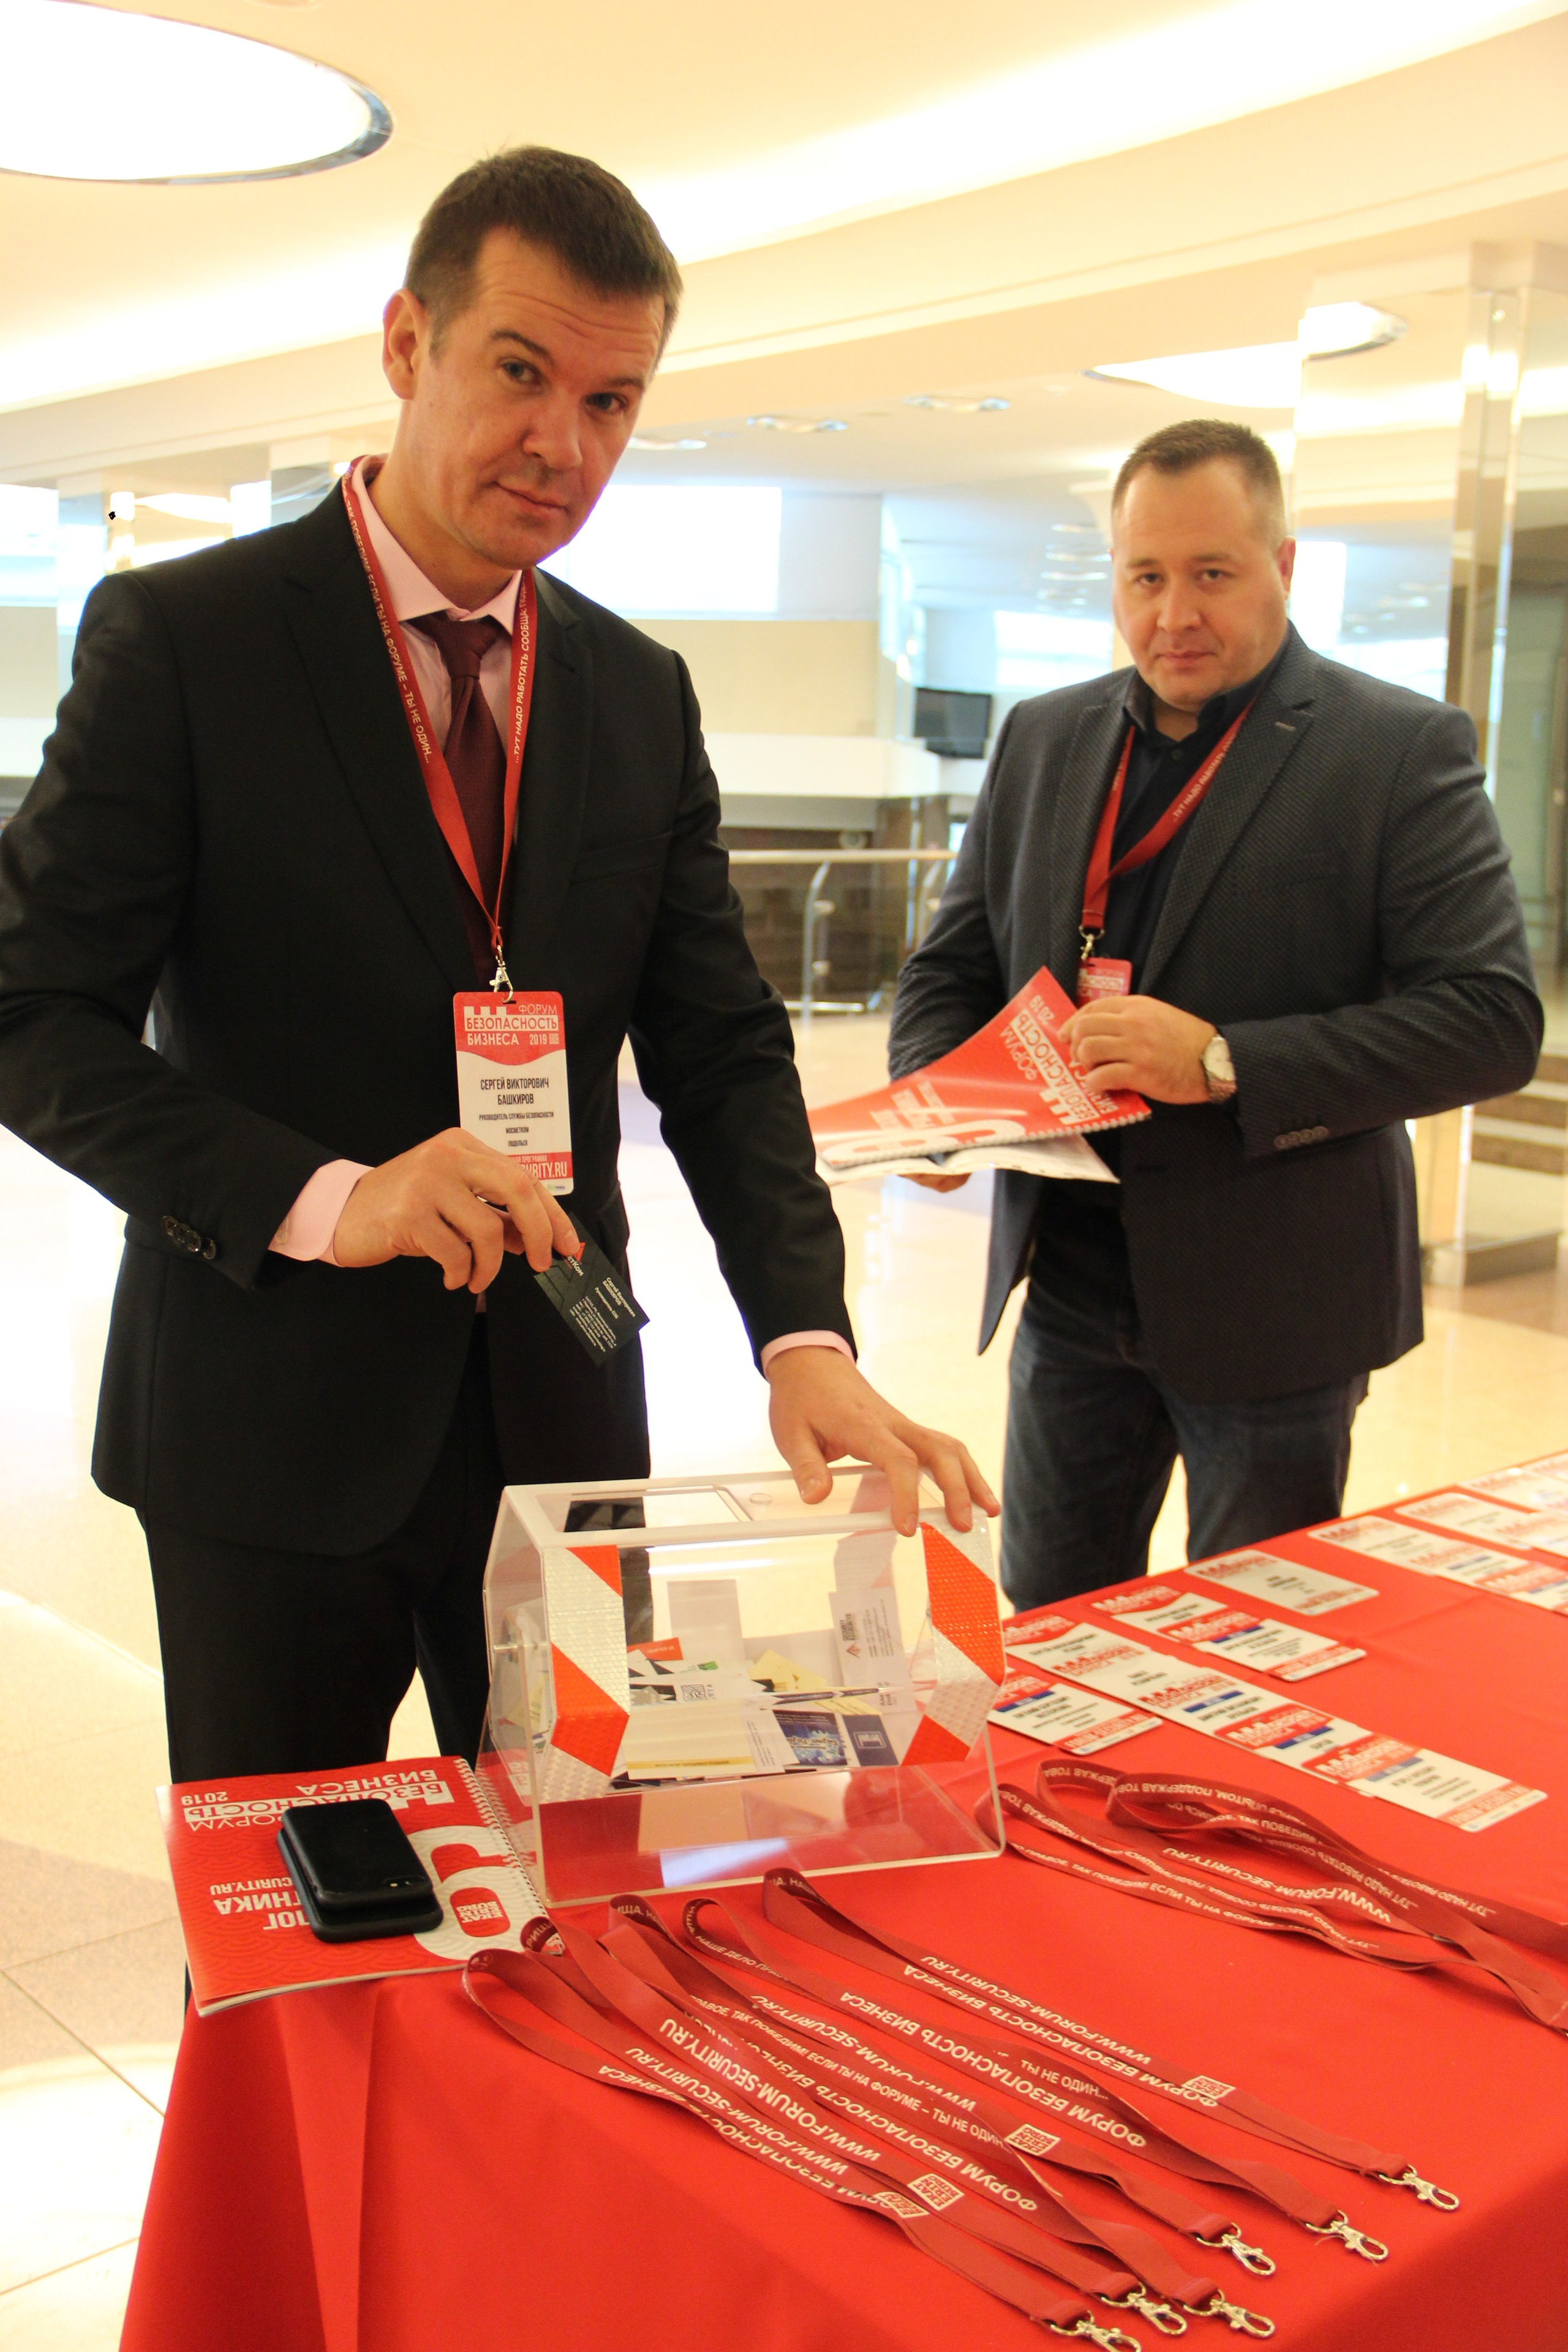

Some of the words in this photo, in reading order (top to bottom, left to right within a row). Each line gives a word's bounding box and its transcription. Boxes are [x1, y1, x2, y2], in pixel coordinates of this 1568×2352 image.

[375, 603, 386, 619] ТЫ
[382, 620, 392, 638] НА
[386, 638, 407, 682] ФОРУМЕ
[516, 653, 529, 705] РАБОТАТЬ
[404, 692, 417, 709] ТЫ
[410, 709, 421, 724] НЕ
[514, 705, 524, 735] НАДО
[467, 1017, 557, 1030] БЕЗОПАСНОСТЬ
[518, 1003, 557, 1015] ФОРУМ
[467, 1032, 519, 1046] БИЗНЕСА
[529, 1033, 547, 1045] 2019
[1000, 1026, 1038, 1080] ФОРУМ
[1017, 1013, 1098, 1120] БЕЗОПАСНОСТЬ
[480, 1077, 505, 1090] СЕРГЕЙ
[506, 1077, 549, 1090] ВИКТОРОВИЧ
[497, 1093, 534, 1106] БАШКИРОВ
[526, 1111, 554, 1120] БЕЗОПАСНОСТИ
[181, 1790, 228, 1805] 2019
[295, 1770, 438, 1795] БИЗНЕСА
[1142, 1782, 1213, 1796] ПОДДЕРЖАВ
[188, 1814, 283, 1832] ОРУМ
[1317, 1850, 1364, 1883] РАБОТАТЬ
[209, 1877, 291, 1896] CURITY.RU
[1150, 1881, 1184, 1901] ЕСЛИ
[1184, 1894, 1202, 1910] ТЫ
[1202, 1902, 1221, 1915] НА
[1161, 1847, 1393, 1923] WWW.FORUM-SECURITY.RU
[1363, 1875, 1393, 1899] НАДО
[695, 1935, 727, 1954] НАШЕ
[903, 1964, 987, 2010] БИЗНЕСА
[839, 1991, 921, 2036] БИЗНЕСА
[921, 1955, 1152, 2065] WWW.FORUM-SECURITY.RU
[988, 2005, 1140, 2078] БЕЗОПАСНОСТЬ
[733, 2008, 752, 2023] ТАК
[750, 2018, 807, 2056] ПОБЕДИМ!
[806, 2051, 837, 2071] ЕСЛИ
[837, 2064, 853, 2078] ТЫ
[853, 2071, 870, 2087] НА
[870, 2081, 921, 2111] ФОРУМЕ
[932, 2107, 951, 2122] ТЫ
[951, 2115, 968, 2133] НЕ
[920, 2028, 1070, 2111] БЕЗОПАСНОСТЬ
[1021, 2059, 1040, 2075] ТЫ
[1041, 2068, 1060, 2083] НЕ
[658, 2018, 882, 2162] WWW.FORUM-SECURITY.RU
[1139, 2072, 1218, 2108] ФОРУМ
[624, 2046, 850, 2176] WWW.FORUM-SECURITY.RU
[1067, 2105, 1147, 2147] ФОРУМ
[816, 2085, 964, 2169] БЕЗОПАСНОСТЬ
[961, 2162, 1038, 2211] ФОРУМ
